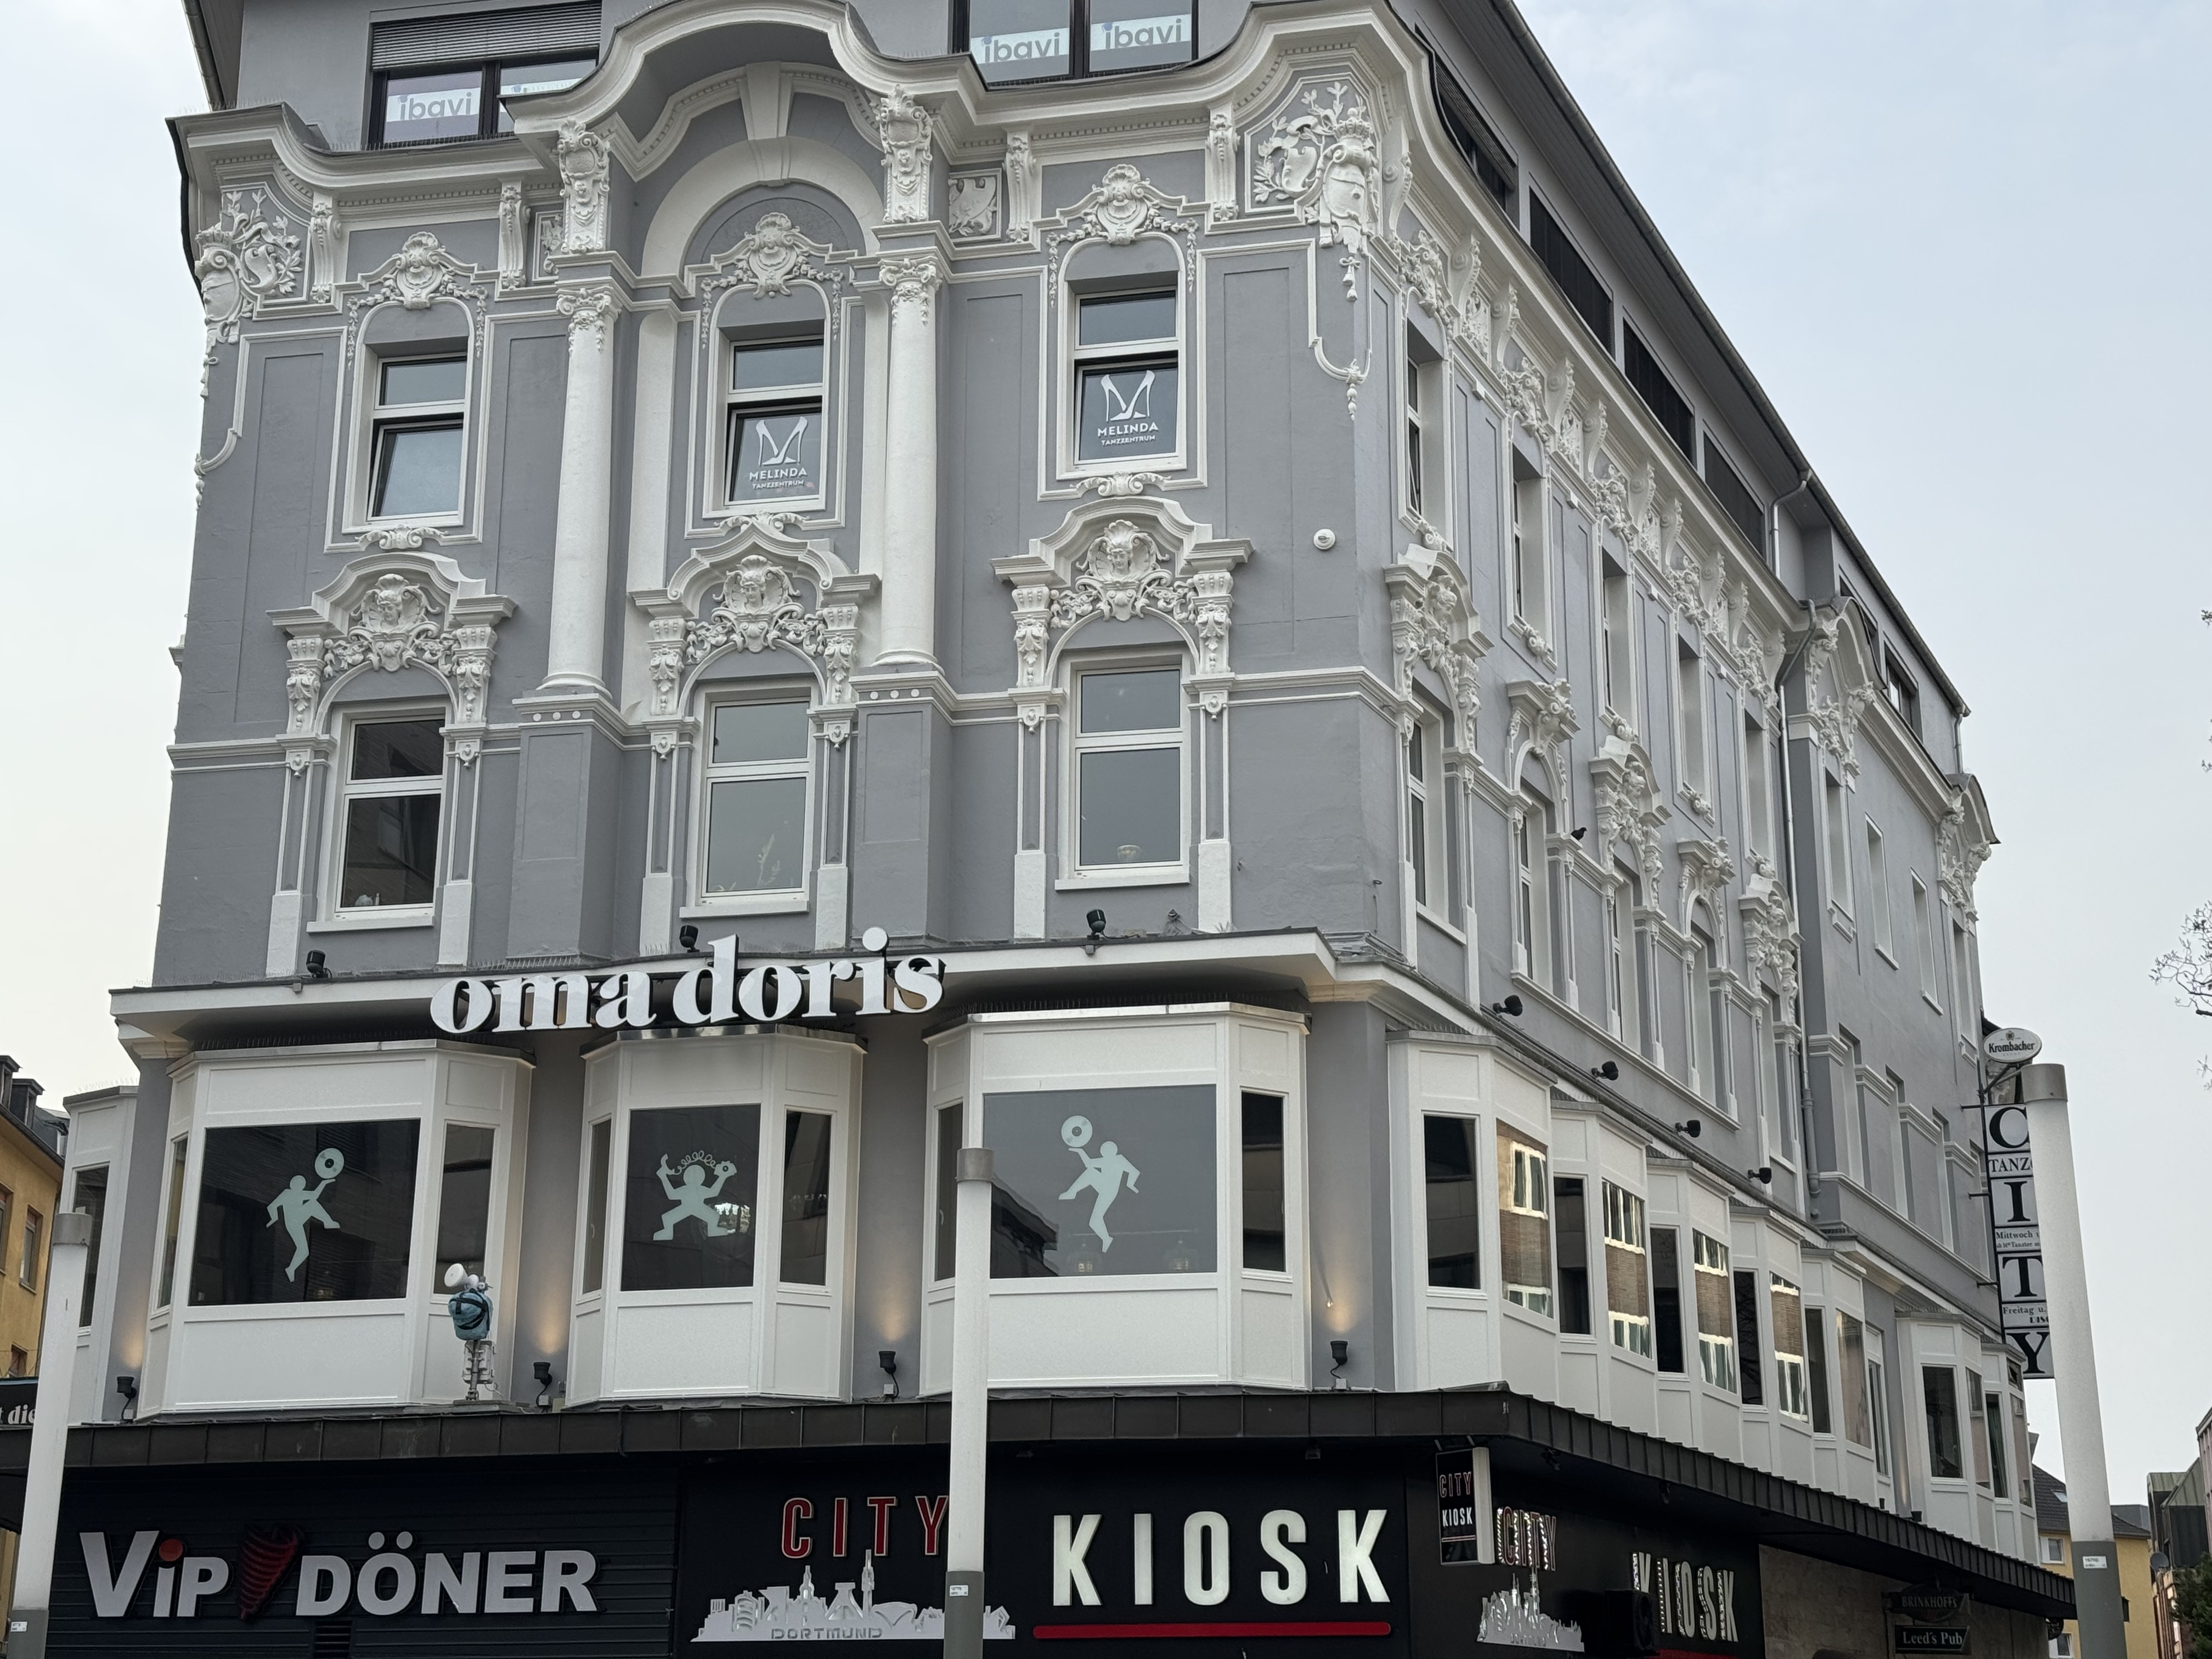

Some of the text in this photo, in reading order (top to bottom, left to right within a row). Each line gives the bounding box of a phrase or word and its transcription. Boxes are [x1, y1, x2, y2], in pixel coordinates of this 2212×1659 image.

[1103, 18, 1182, 49] ibavi
[982, 32, 1060, 63] ibavi
[398, 92, 472, 121] ibavi
[1098, 422, 1159, 437] MELINDA
[1101, 435, 1155, 446] TANZZENTRUM
[749, 467, 807, 481] MELINDA
[752, 480, 804, 490] TANZZENTRUM
[430, 926, 945, 1035] oma doris
[1989, 1041, 2035, 1053] Krombacher
[1988, 1157, 2033, 1172] TANZ
[1996, 1231, 2033, 1239] Mittwoch
[2003, 1306, 2034, 1316] Freitag
[1440, 1471, 1472, 1498] CITY
[1442, 1507, 1472, 1527] KIOSK
[782, 1496, 949, 1558] CITY
[1497, 1506, 1556, 1571] CITY
[1053, 1509, 1390, 1605] KIOSK
[296, 1531, 597, 1616] DÖNER
[771, 1628, 883, 1639] DORTMUND
[1940, 1632, 1963, 1645] Pub
